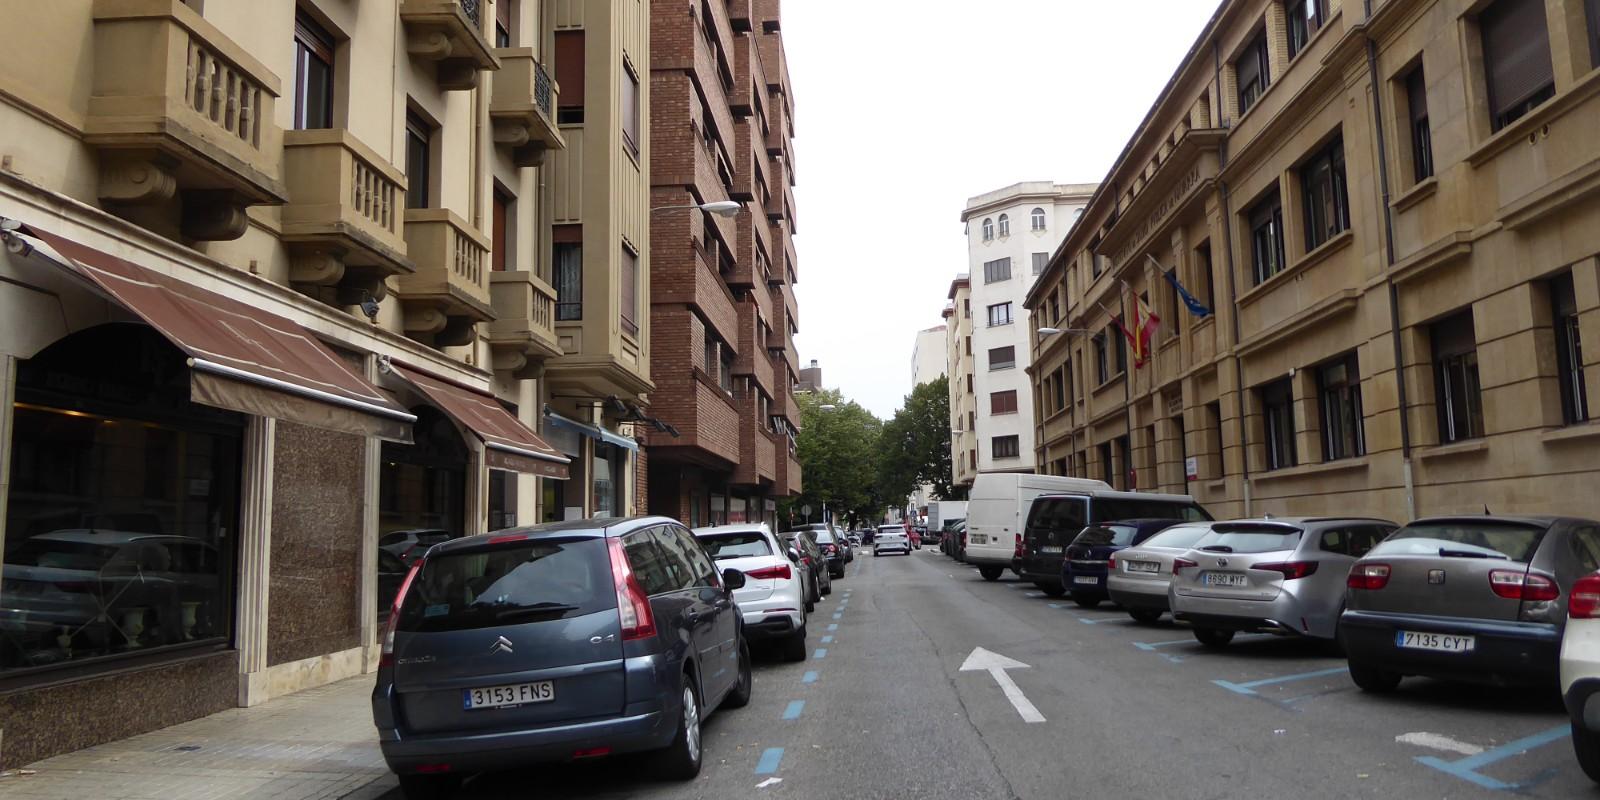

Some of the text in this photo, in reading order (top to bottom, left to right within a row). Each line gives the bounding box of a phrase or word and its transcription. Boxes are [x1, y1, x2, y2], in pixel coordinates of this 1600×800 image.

[1406, 632, 1471, 651] 7135 CYT
[474, 683, 551, 705] 3153 FNS
